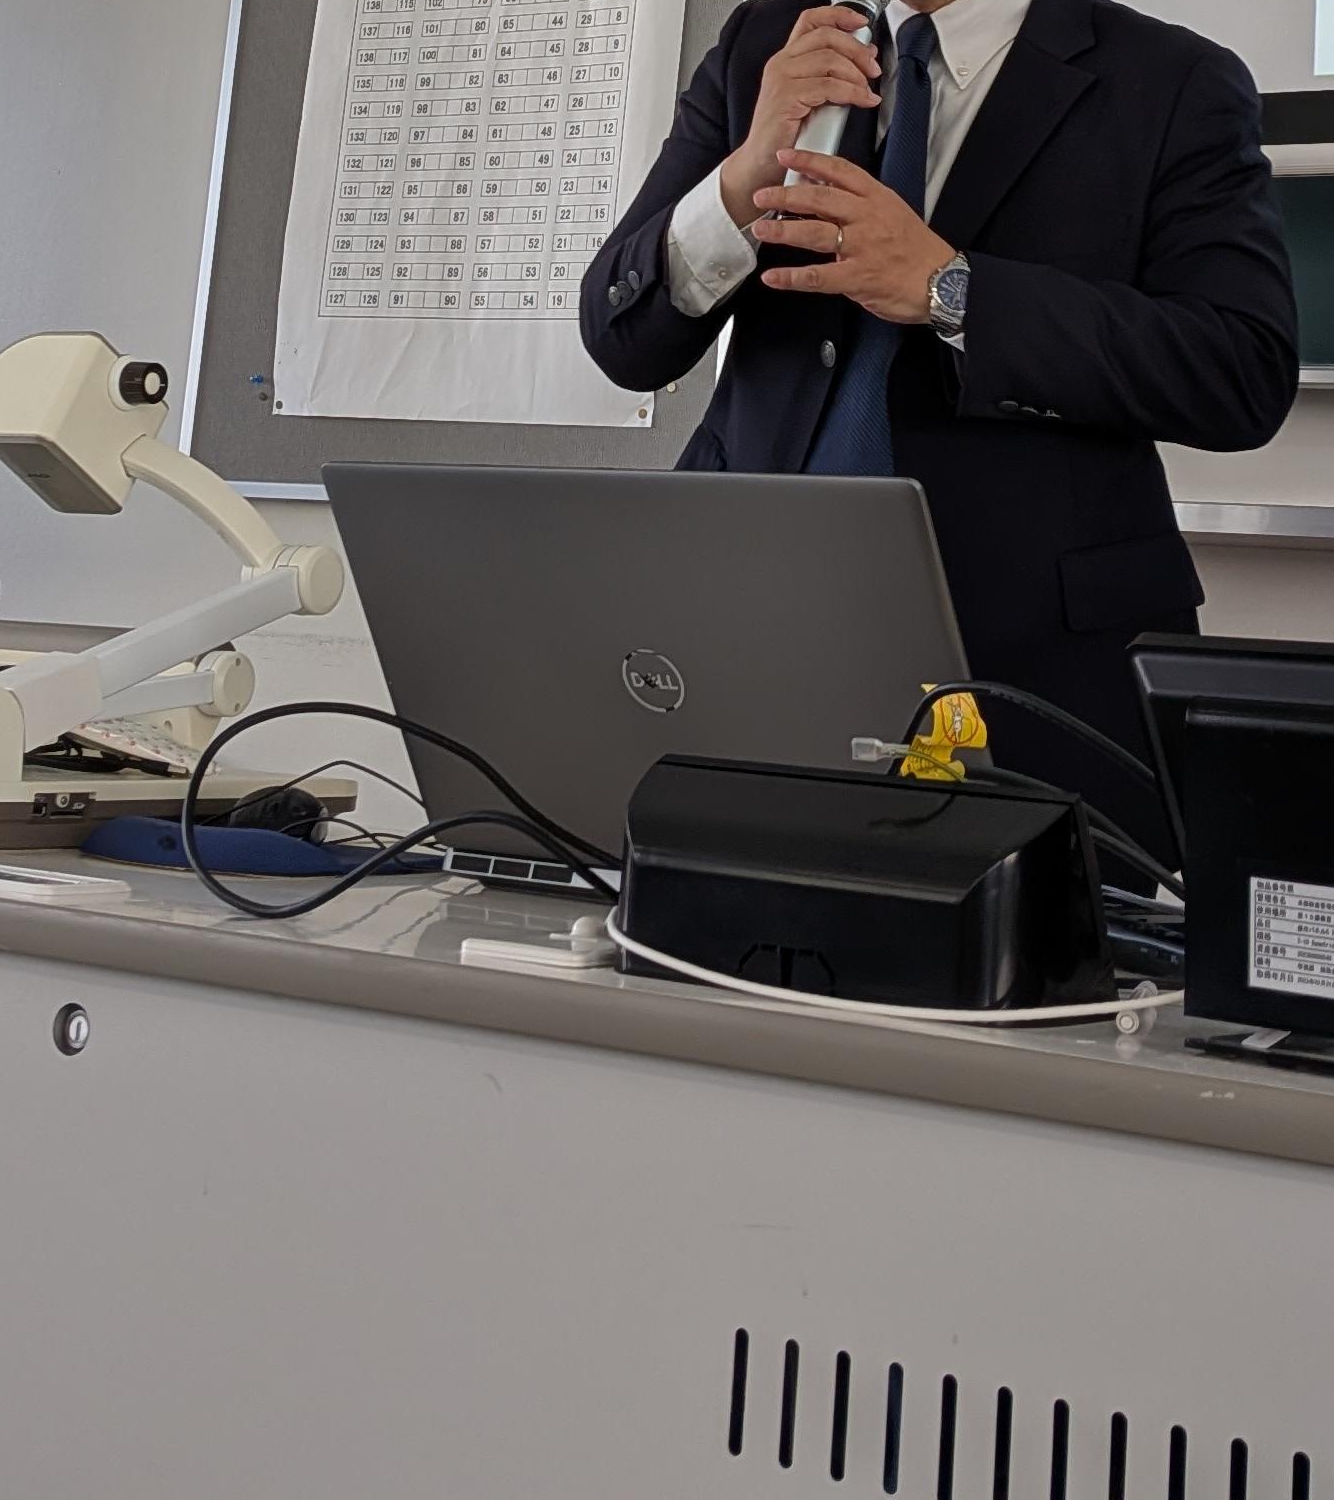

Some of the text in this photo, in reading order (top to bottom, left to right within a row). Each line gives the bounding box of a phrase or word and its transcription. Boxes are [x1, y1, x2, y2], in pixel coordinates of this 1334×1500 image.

[366, 0, 381, 11] 138
[353, 94, 616, 116] 134 119 98 83 47 26 11
[379, 150, 611, 169] 121 96 85 60 49 24 13
[339, 207, 606, 223] 130 123 94 87 58 51 22 15
[336, 237, 603, 250] 129 124 93 88 57 52 21 16
[332, 266, 566, 278] 128 125 92 89 56 53 20
